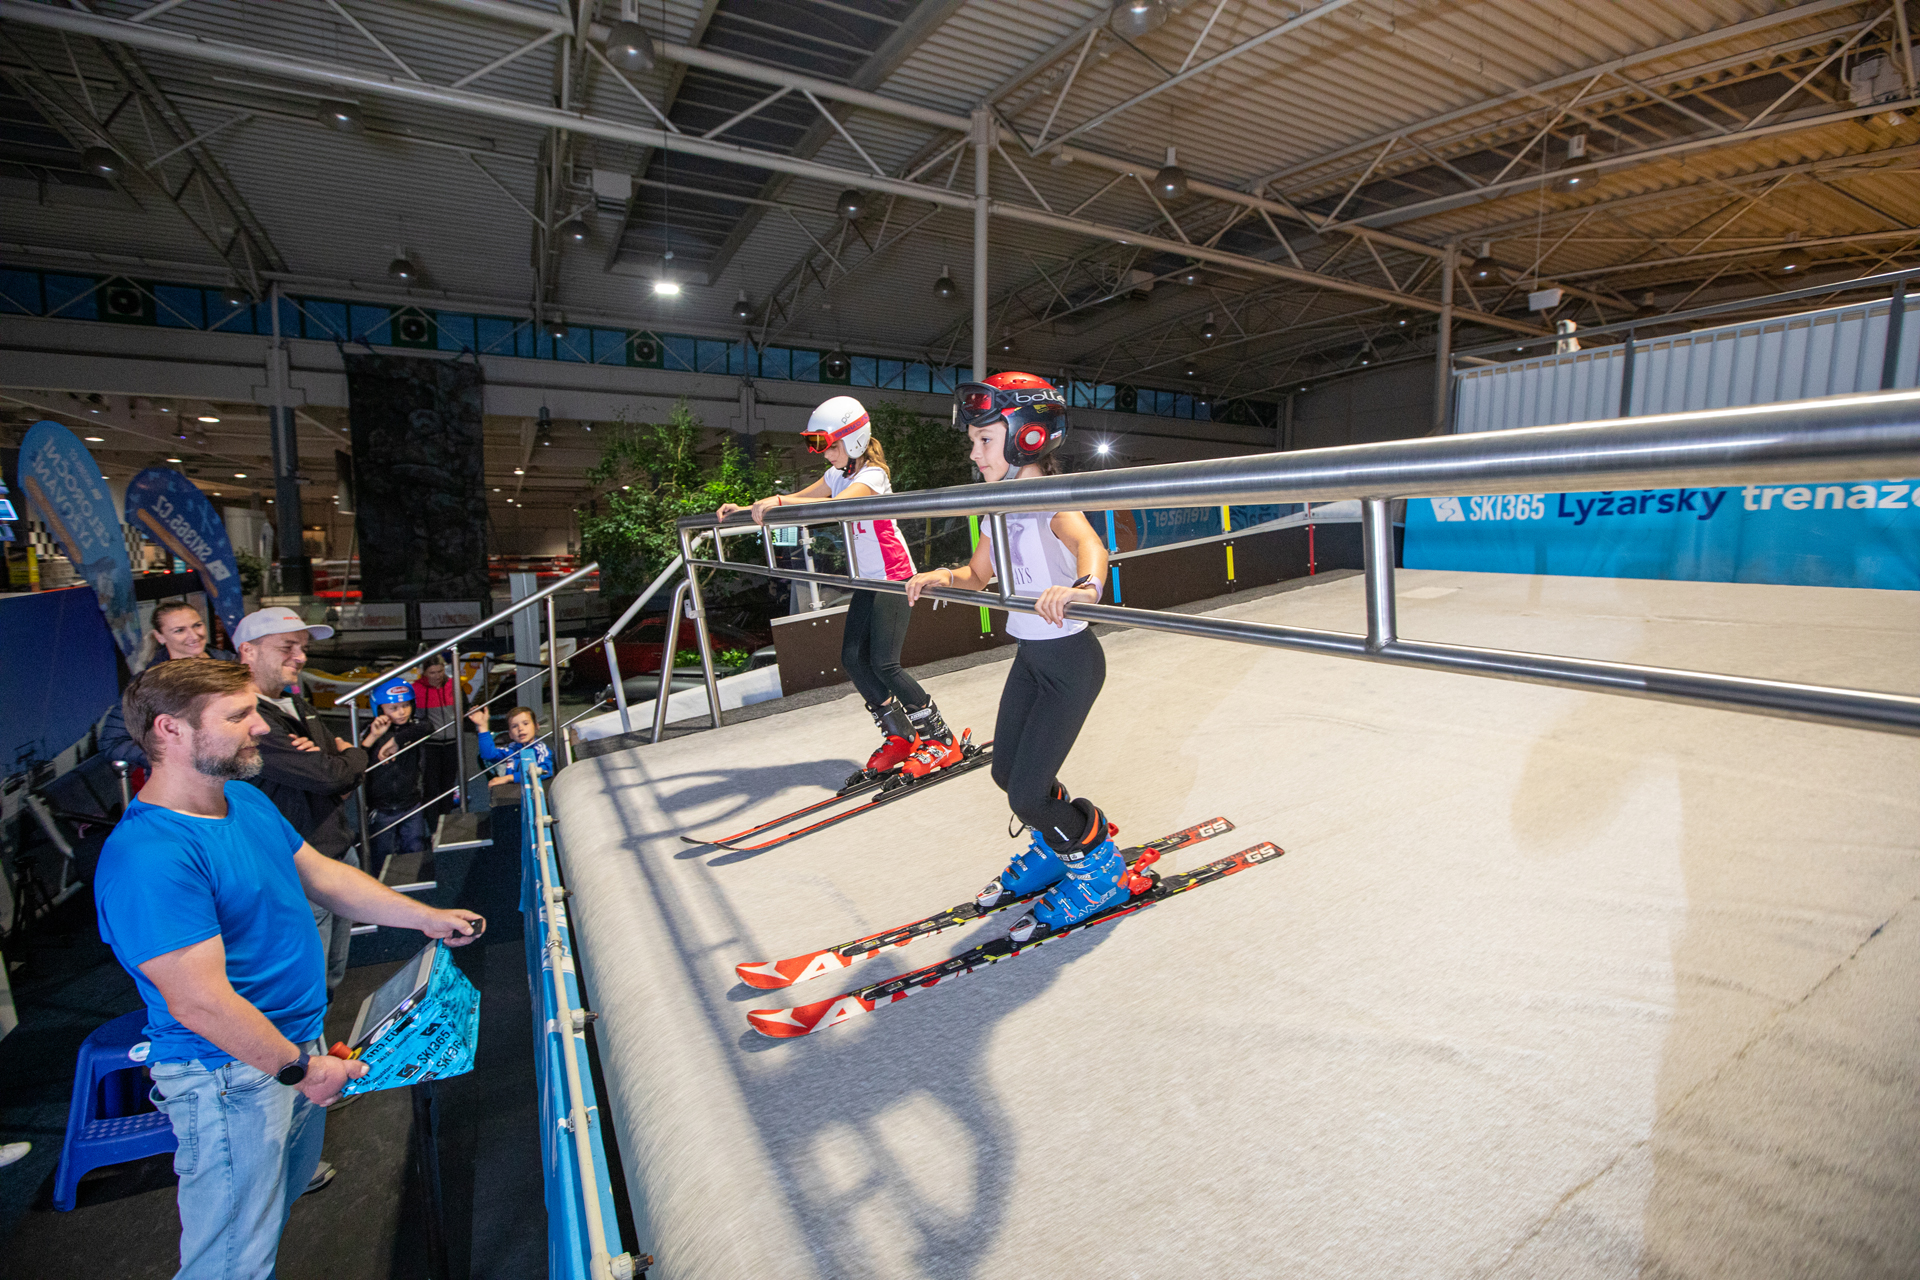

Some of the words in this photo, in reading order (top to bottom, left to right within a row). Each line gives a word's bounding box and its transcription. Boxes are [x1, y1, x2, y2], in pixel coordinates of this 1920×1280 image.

[1469, 494, 1545, 521] SKI365
[1741, 478, 1920, 511] trenaž
[1014, 567, 1032, 585] AYS
[1199, 820, 1228, 838] GS
[1245, 845, 1276, 863] GS
